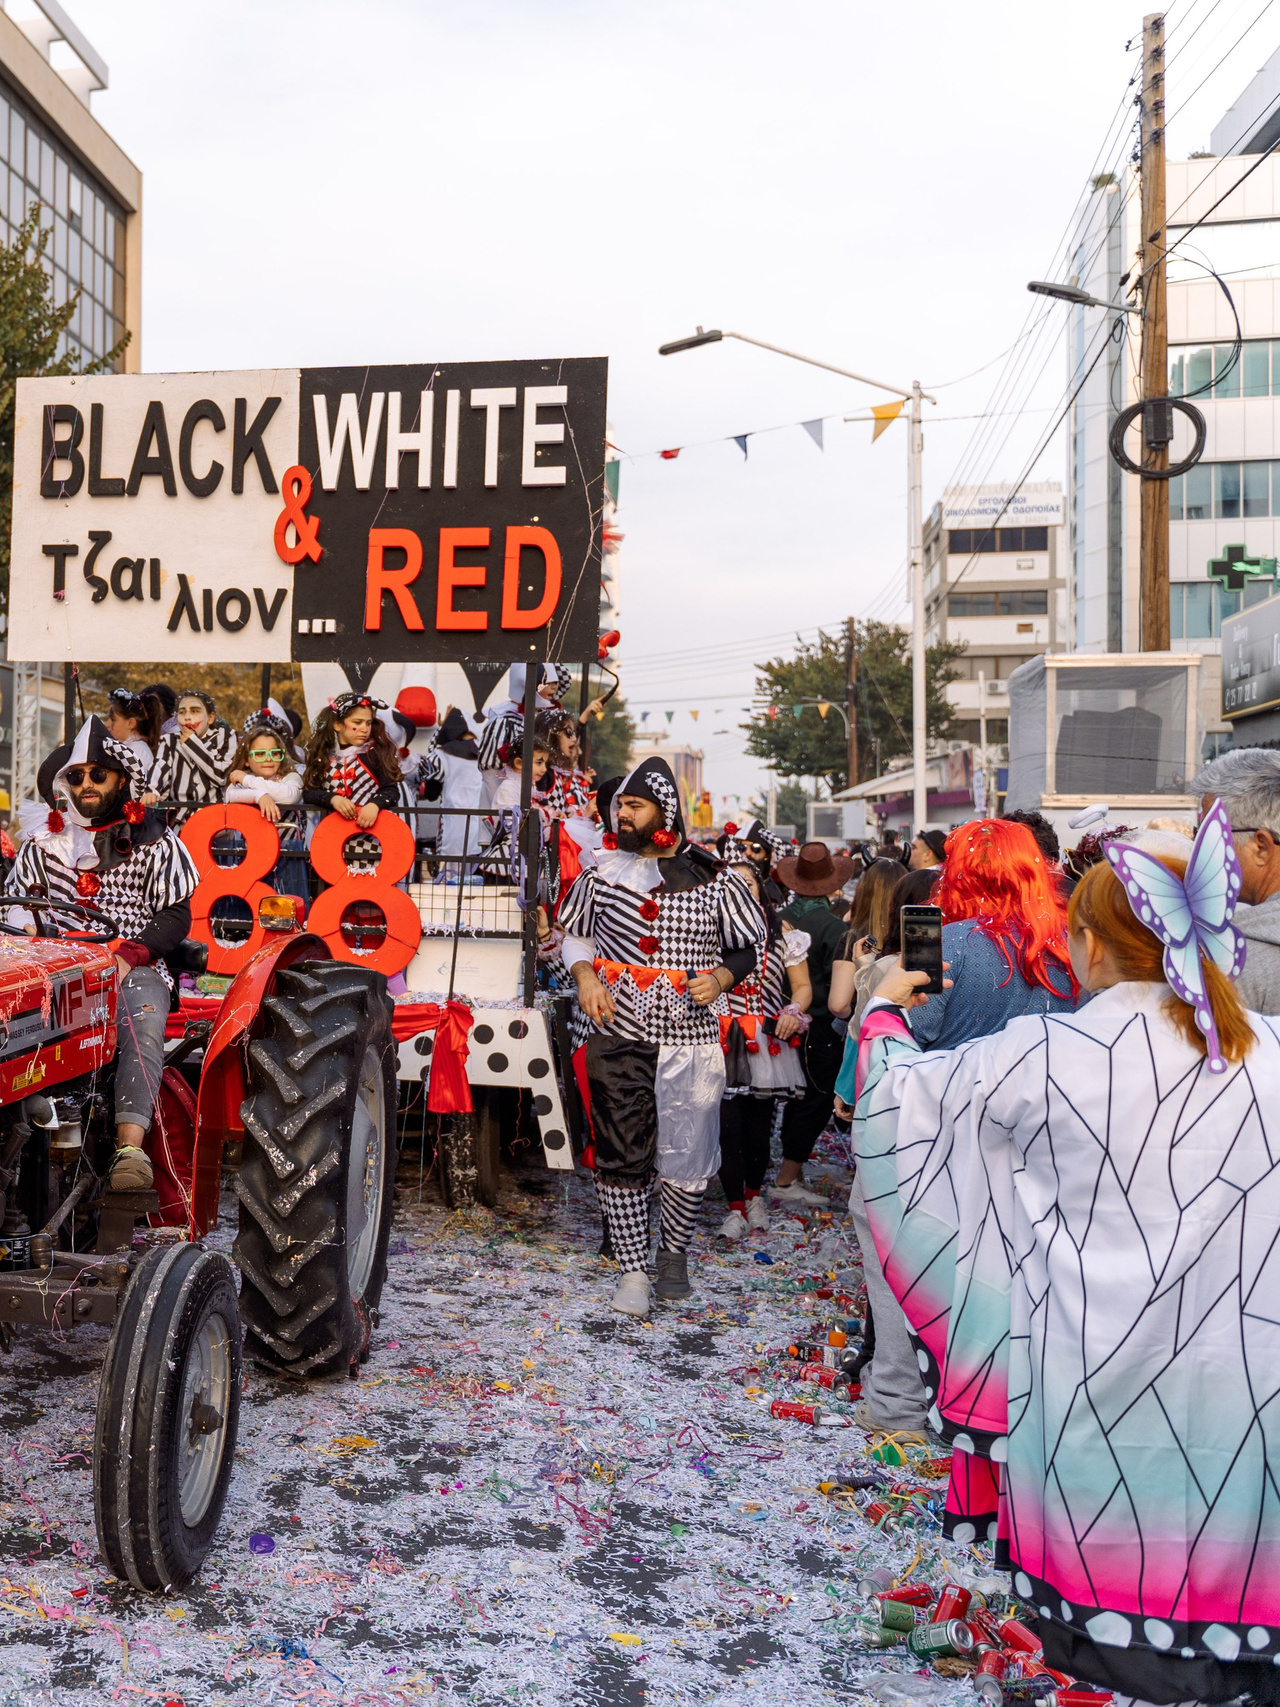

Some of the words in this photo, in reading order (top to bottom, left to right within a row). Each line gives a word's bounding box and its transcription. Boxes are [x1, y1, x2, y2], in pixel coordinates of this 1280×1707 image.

[40, 396, 282, 498] BLACK
[312, 385, 568, 492] WHITE
[42, 530, 162, 604] Τζαι
[273, 464, 323, 566] &
[365, 524, 563, 633] RED
[9, 1028, 25, 1041] MASSEY
[50, 978, 83, 1031] MF
